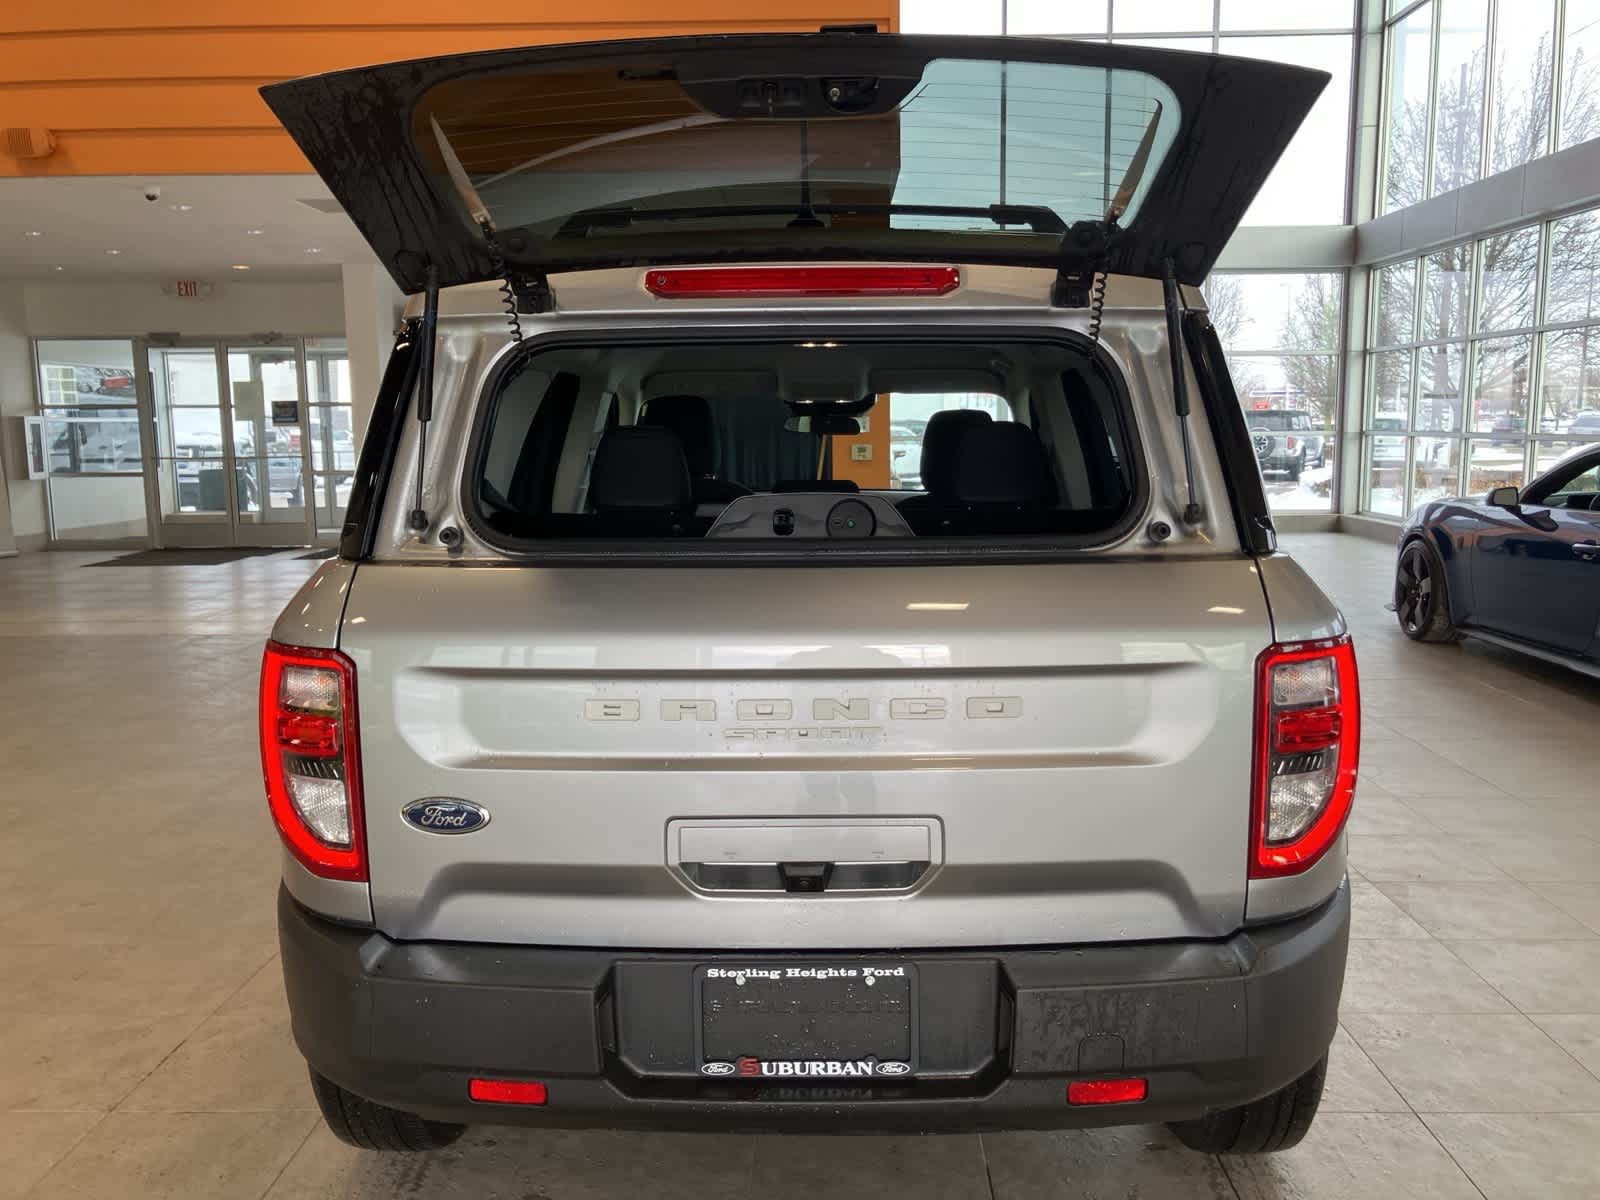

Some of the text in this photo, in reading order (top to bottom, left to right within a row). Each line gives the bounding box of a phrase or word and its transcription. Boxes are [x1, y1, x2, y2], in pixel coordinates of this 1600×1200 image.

[177, 280, 198, 297] EXIT
[584, 698, 1022, 722] BRONCO
[420, 805, 467, 827] Ford
[706, 967, 905, 980] Sterling Heights Ford
[706, 1056, 904, 1077] Ford SUBURBAN Ford
